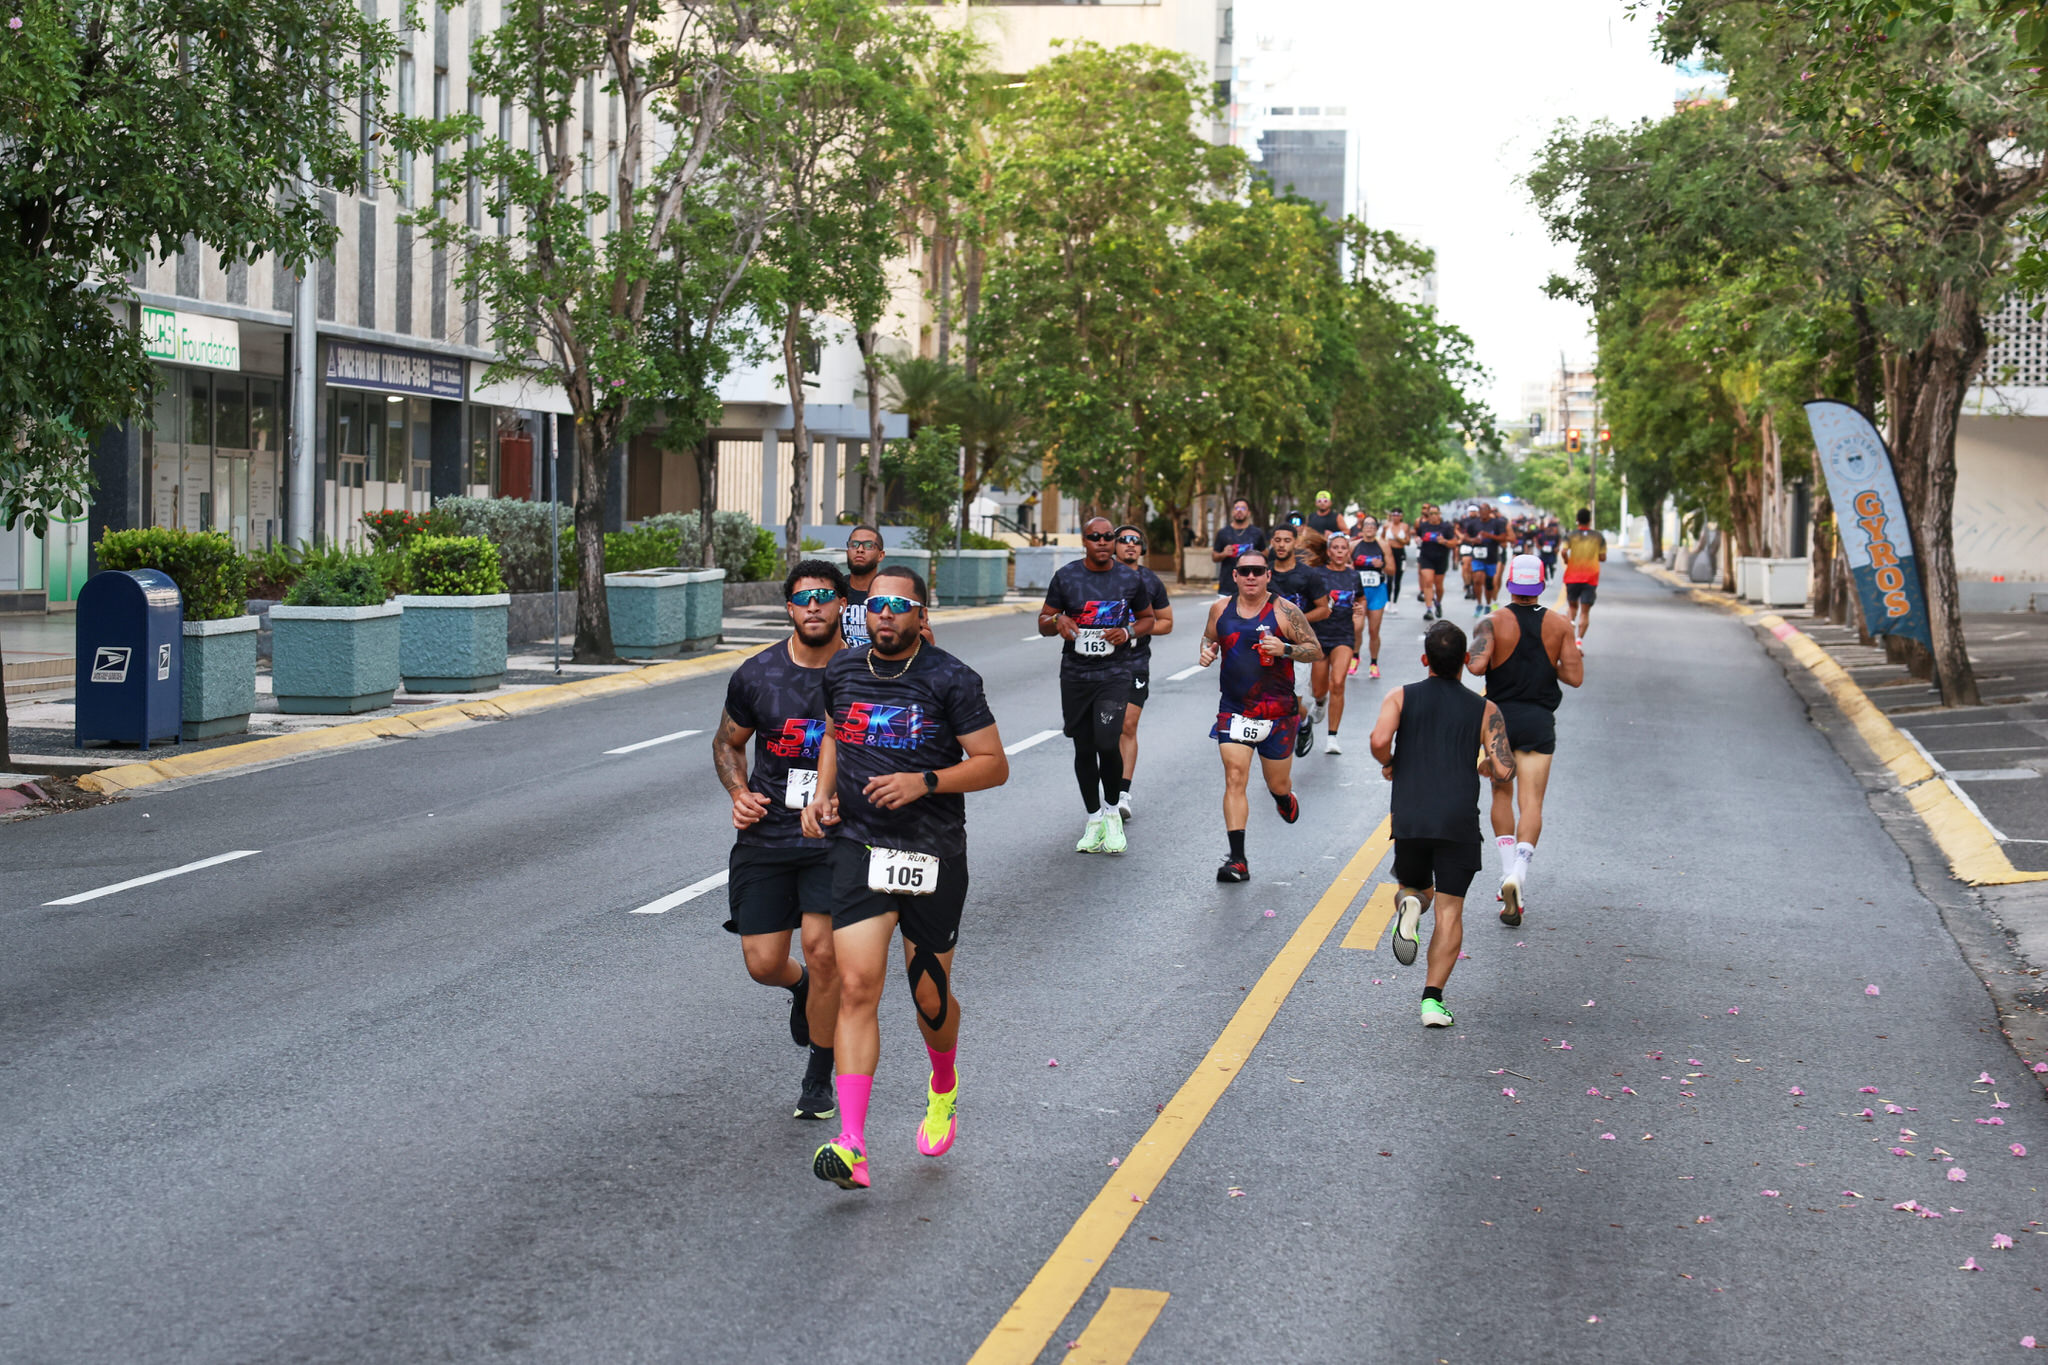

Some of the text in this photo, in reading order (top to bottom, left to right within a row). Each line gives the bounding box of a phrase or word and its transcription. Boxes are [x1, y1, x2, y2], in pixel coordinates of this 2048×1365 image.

[142, 310, 176, 354] MCS
[182, 327, 239, 369] Foundation
[1853, 490, 1911, 618] GYROS
[842, 604, 868, 625] FAD
[1081, 601, 1120, 618] 5K
[1084, 641, 1106, 652] 163
[842, 702, 907, 736] 5K
[780, 718, 826, 748] 5K
[865, 735, 877, 746] &
[1243, 727, 1258, 739] 65
[767, 740, 812, 757] FADE &
[801, 791, 816, 808] 1
[907, 855, 928, 863] RUN
[886, 865, 924, 887] 105
